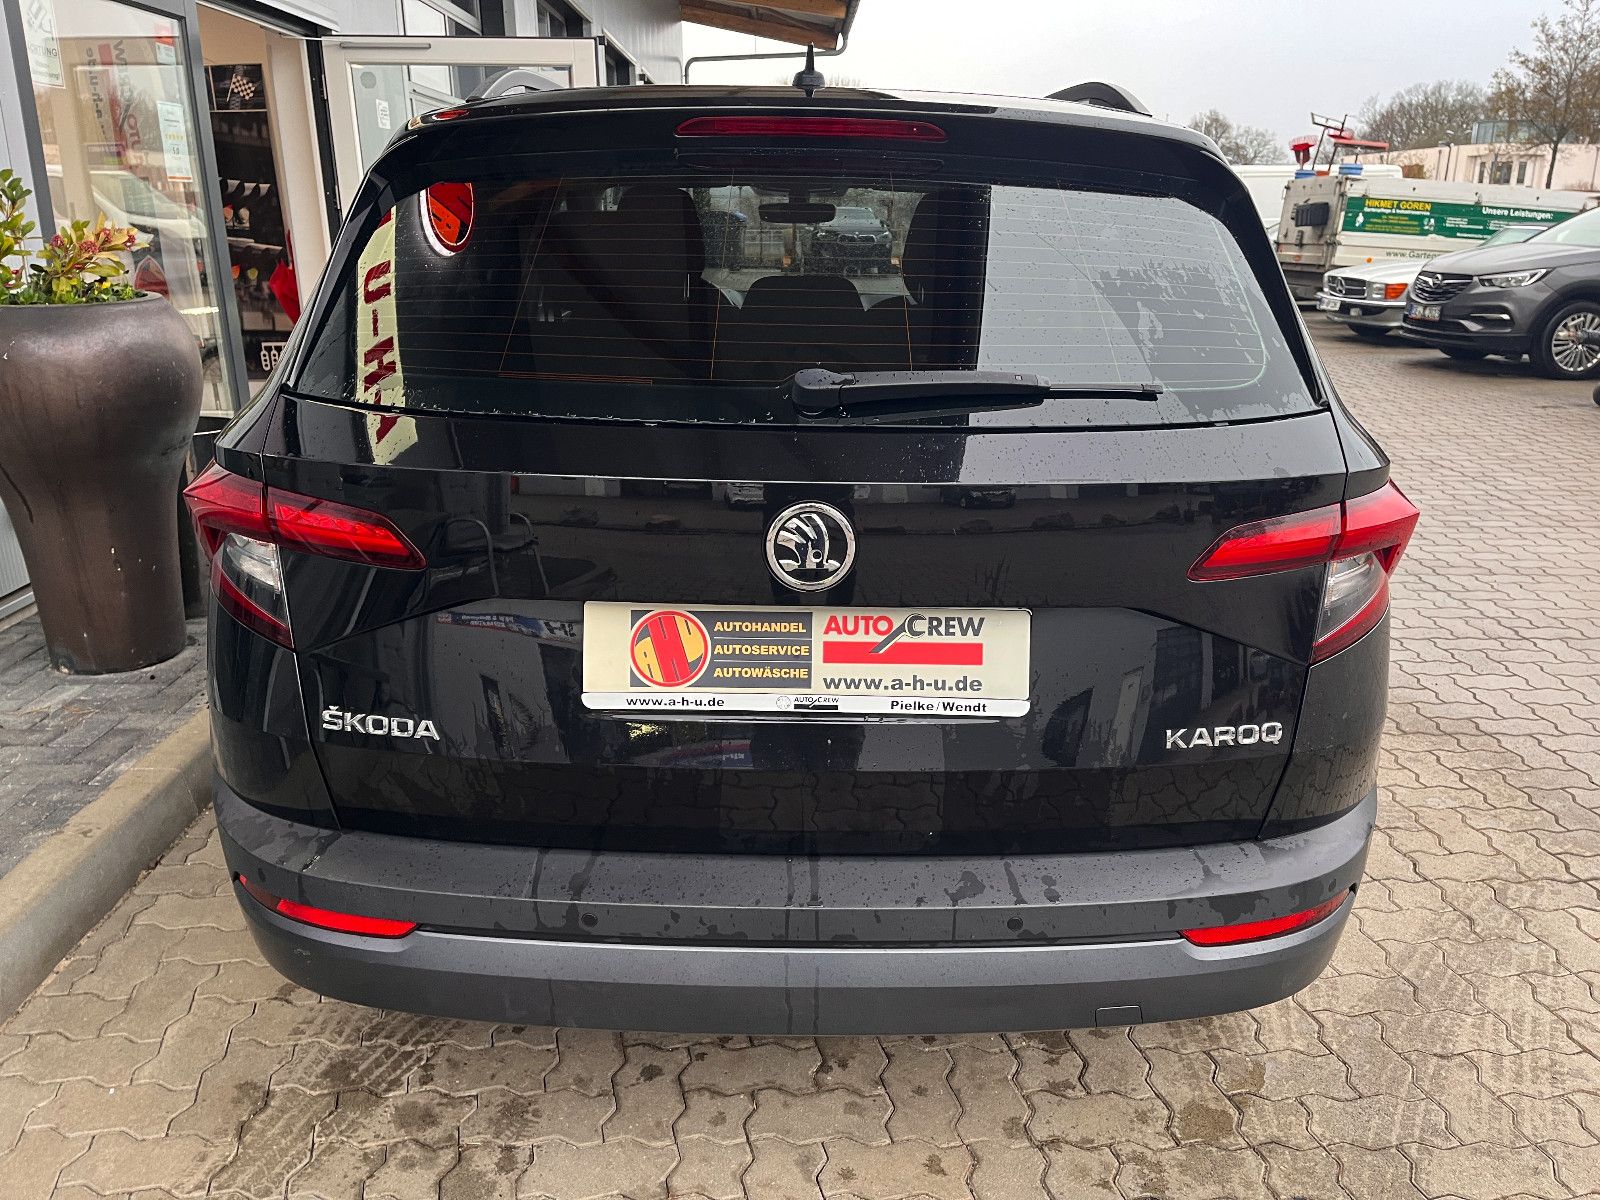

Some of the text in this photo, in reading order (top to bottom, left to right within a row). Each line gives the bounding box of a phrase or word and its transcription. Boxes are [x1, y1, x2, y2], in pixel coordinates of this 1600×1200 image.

[1365, 199, 1399, 209] HIKMET
[1482, 206, 1554, 221] Unsere Leistungen:
[713, 620, 807, 634] AUTOHANDEL
[823, 613, 985, 637] AUTO CREW
[713, 643, 810, 657] AUTOSERVICE
[713, 665, 809, 679] AUTOWÄSCHE
[823, 675, 983, 693] www.a-h-u.de
[626, 695, 725, 708] www.a-h-u.de
[321, 705, 441, 742] ŠKODA
[1165, 721, 1283, 749] KAROQ
